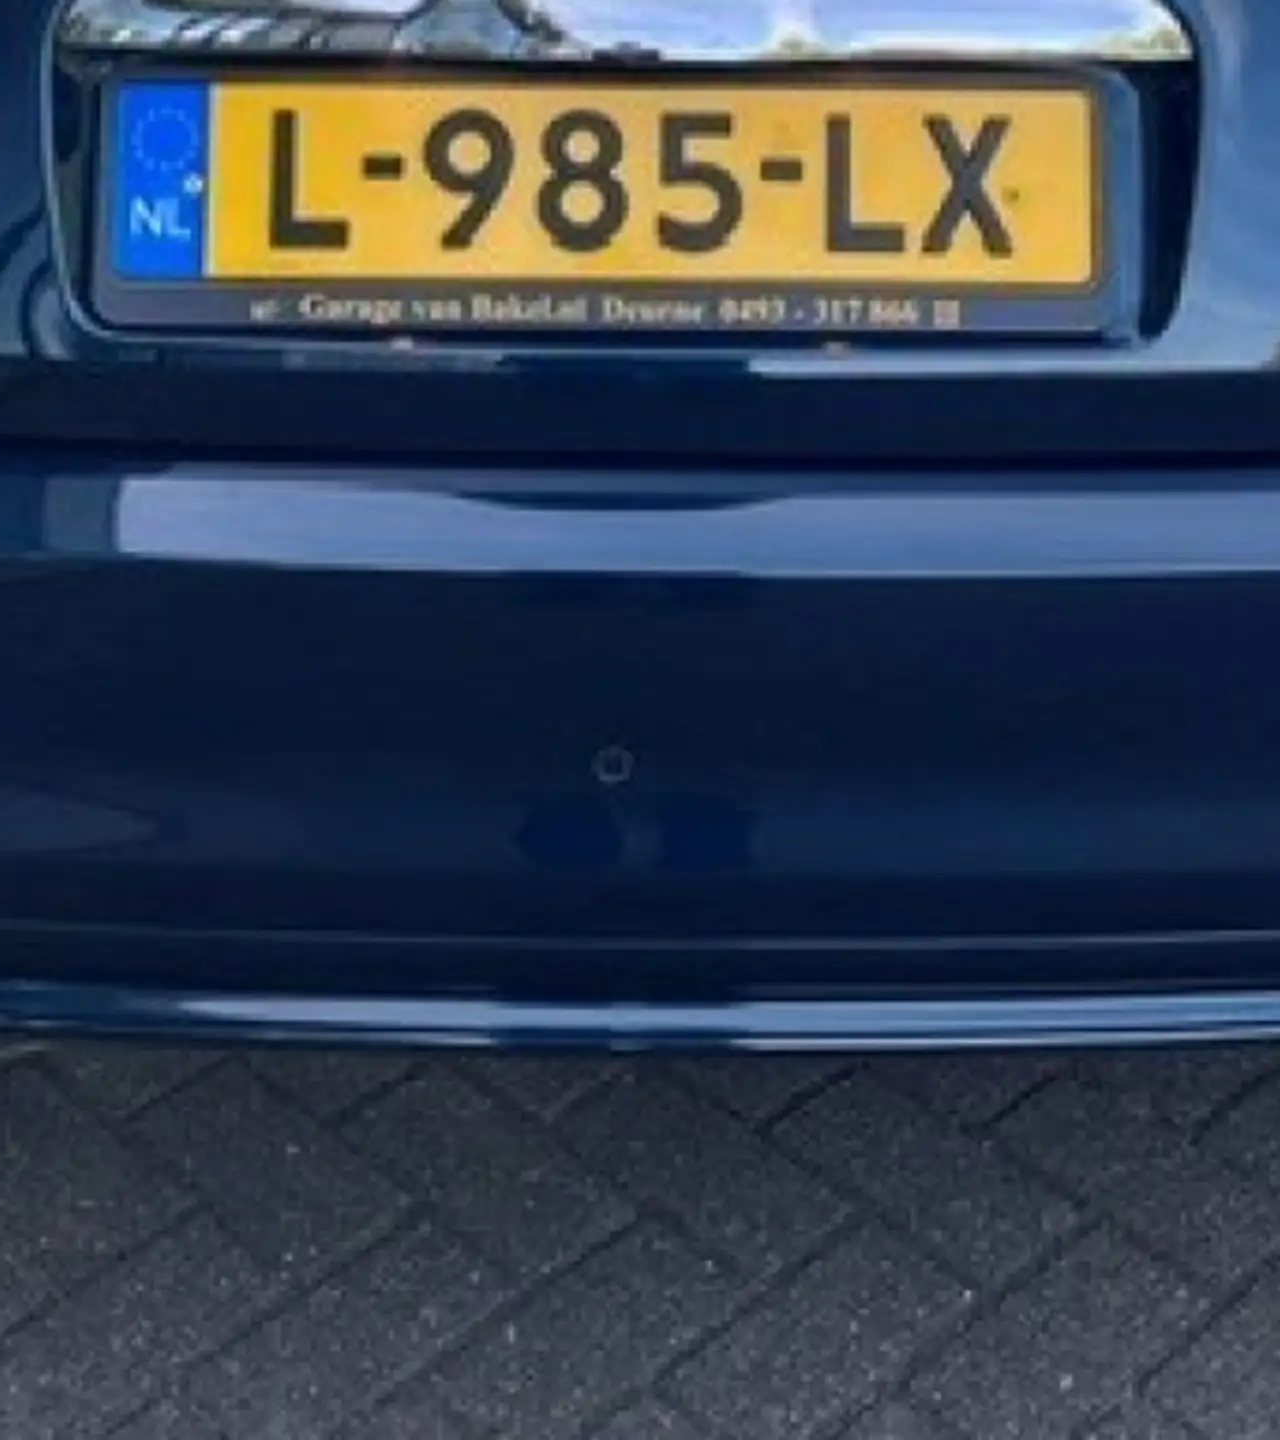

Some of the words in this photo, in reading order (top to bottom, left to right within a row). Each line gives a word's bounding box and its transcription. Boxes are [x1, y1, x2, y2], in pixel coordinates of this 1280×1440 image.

[268, 108, 1014, 256] L-985-LX
[129, 195, 192, 240] NL
[299, 293, 403, 324] Garage
[411, 300, 462, 321] van
